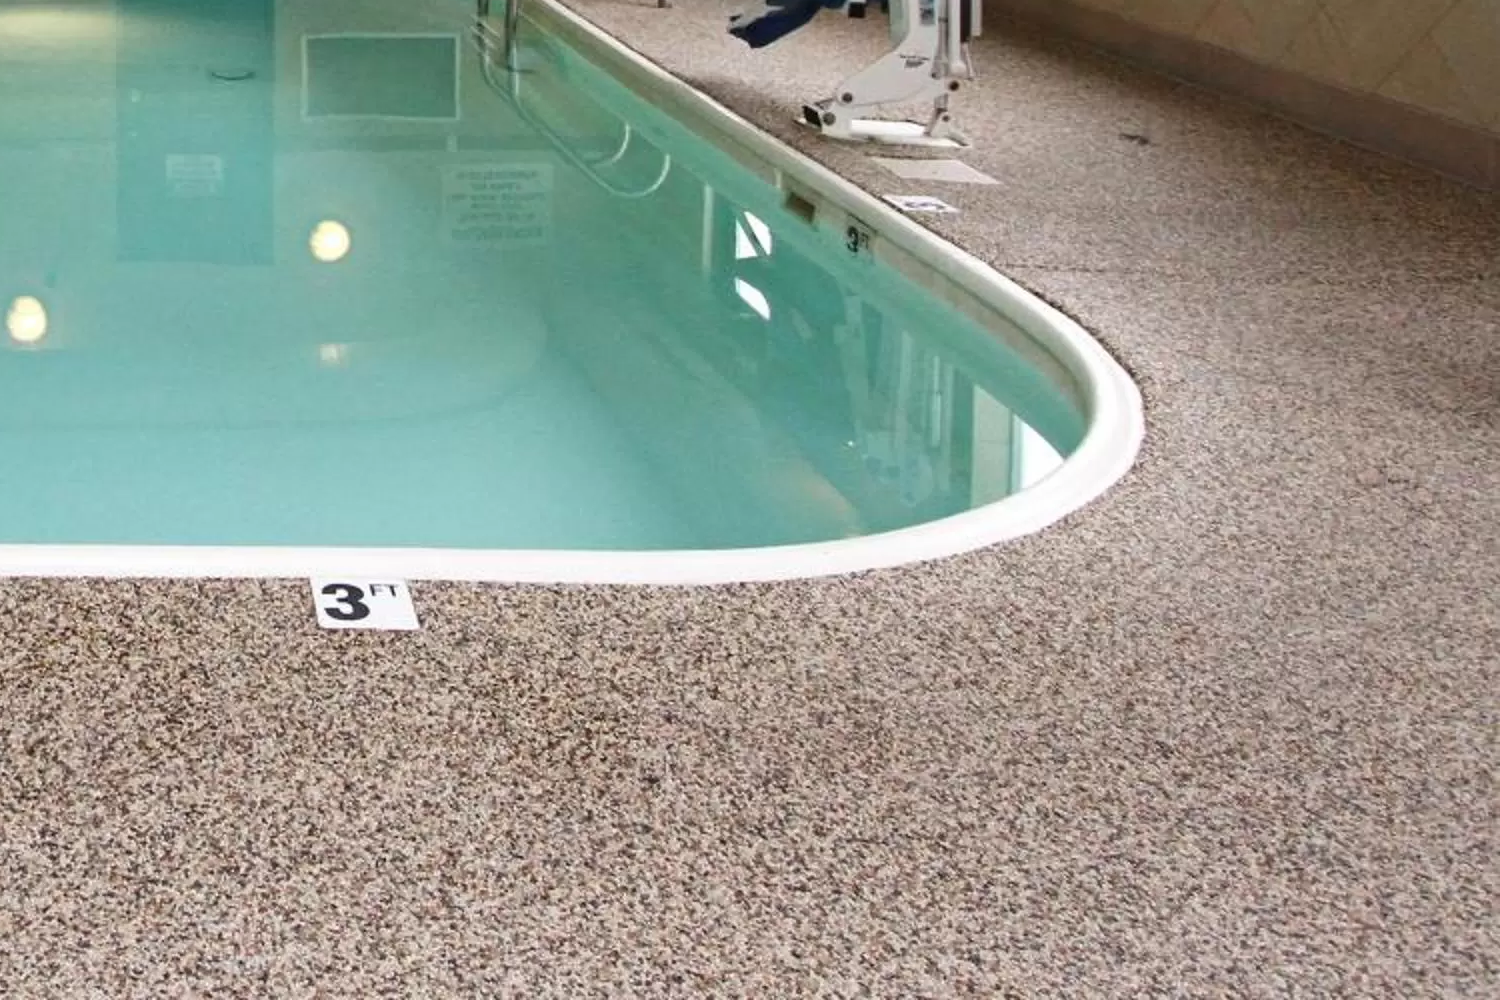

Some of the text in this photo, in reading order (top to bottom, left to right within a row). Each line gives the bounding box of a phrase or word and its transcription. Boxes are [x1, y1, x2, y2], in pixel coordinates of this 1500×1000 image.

[847, 226, 858, 253] 3
[322, 583, 400, 621] 3 FT
